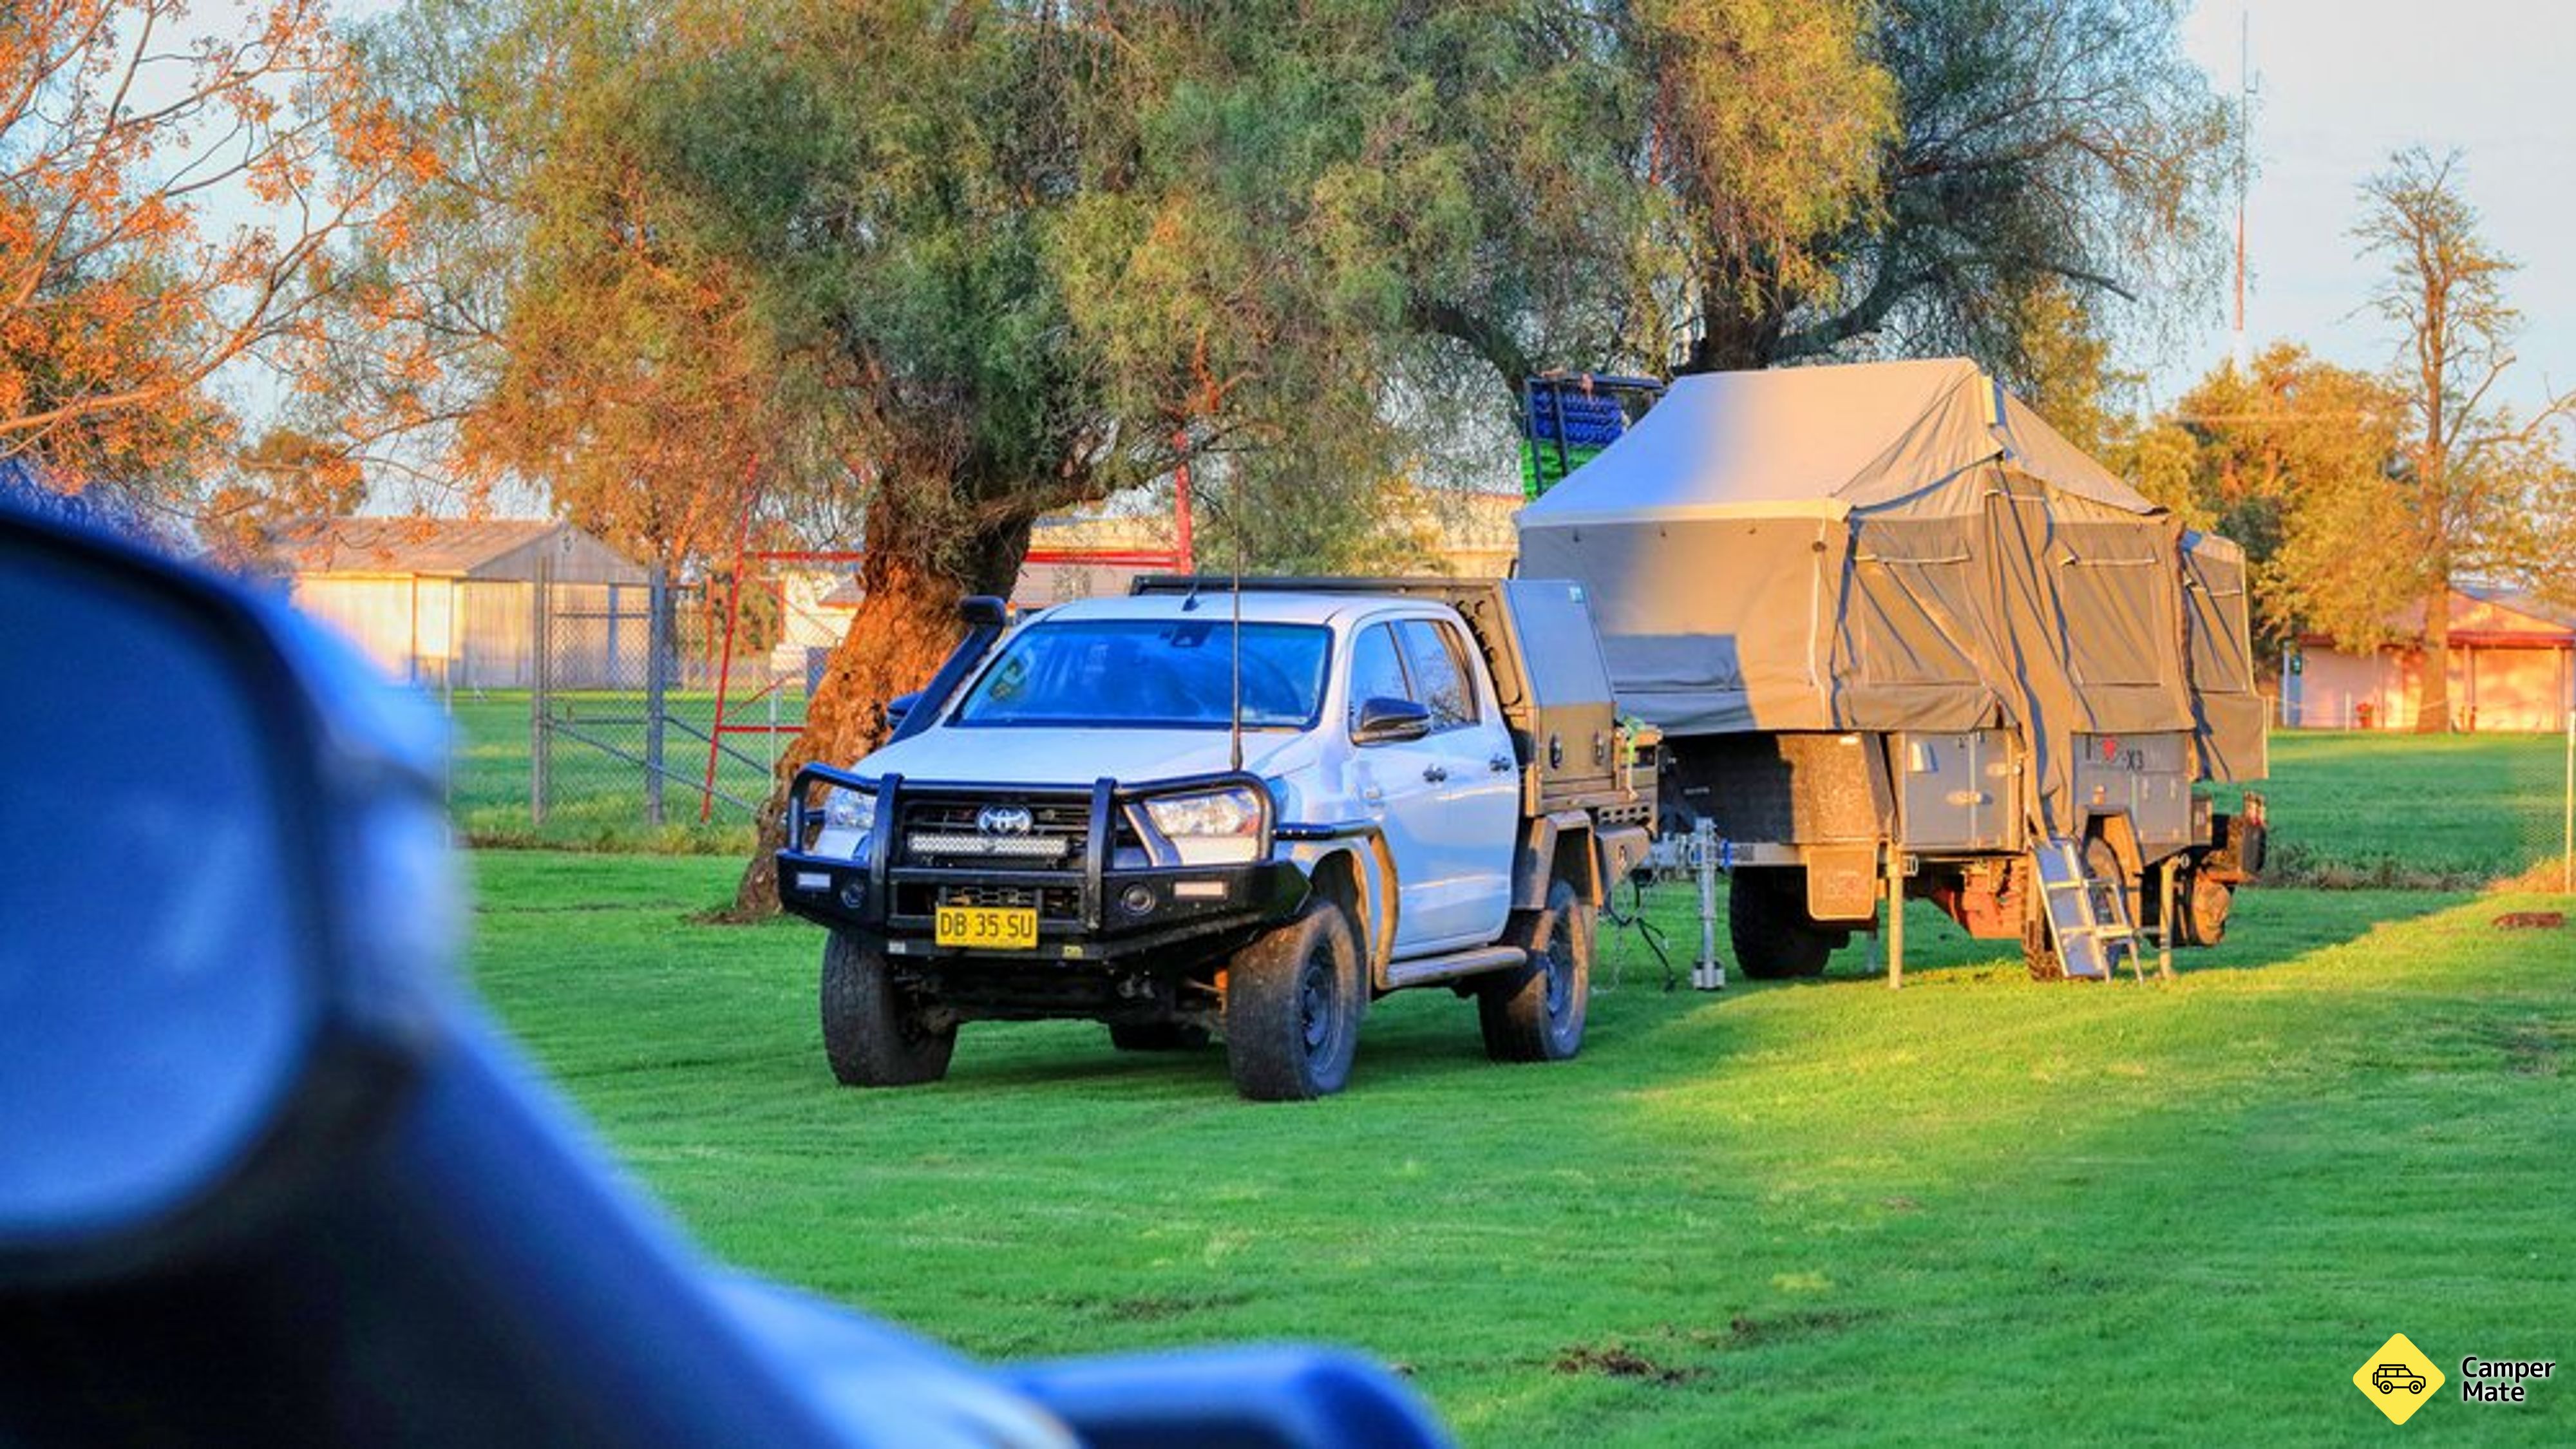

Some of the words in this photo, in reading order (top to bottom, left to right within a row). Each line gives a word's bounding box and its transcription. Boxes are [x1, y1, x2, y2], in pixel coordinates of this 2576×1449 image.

[941, 913, 966, 936] DB
[976, 913, 999, 936] 35
[1007, 914, 1032, 938] SU
